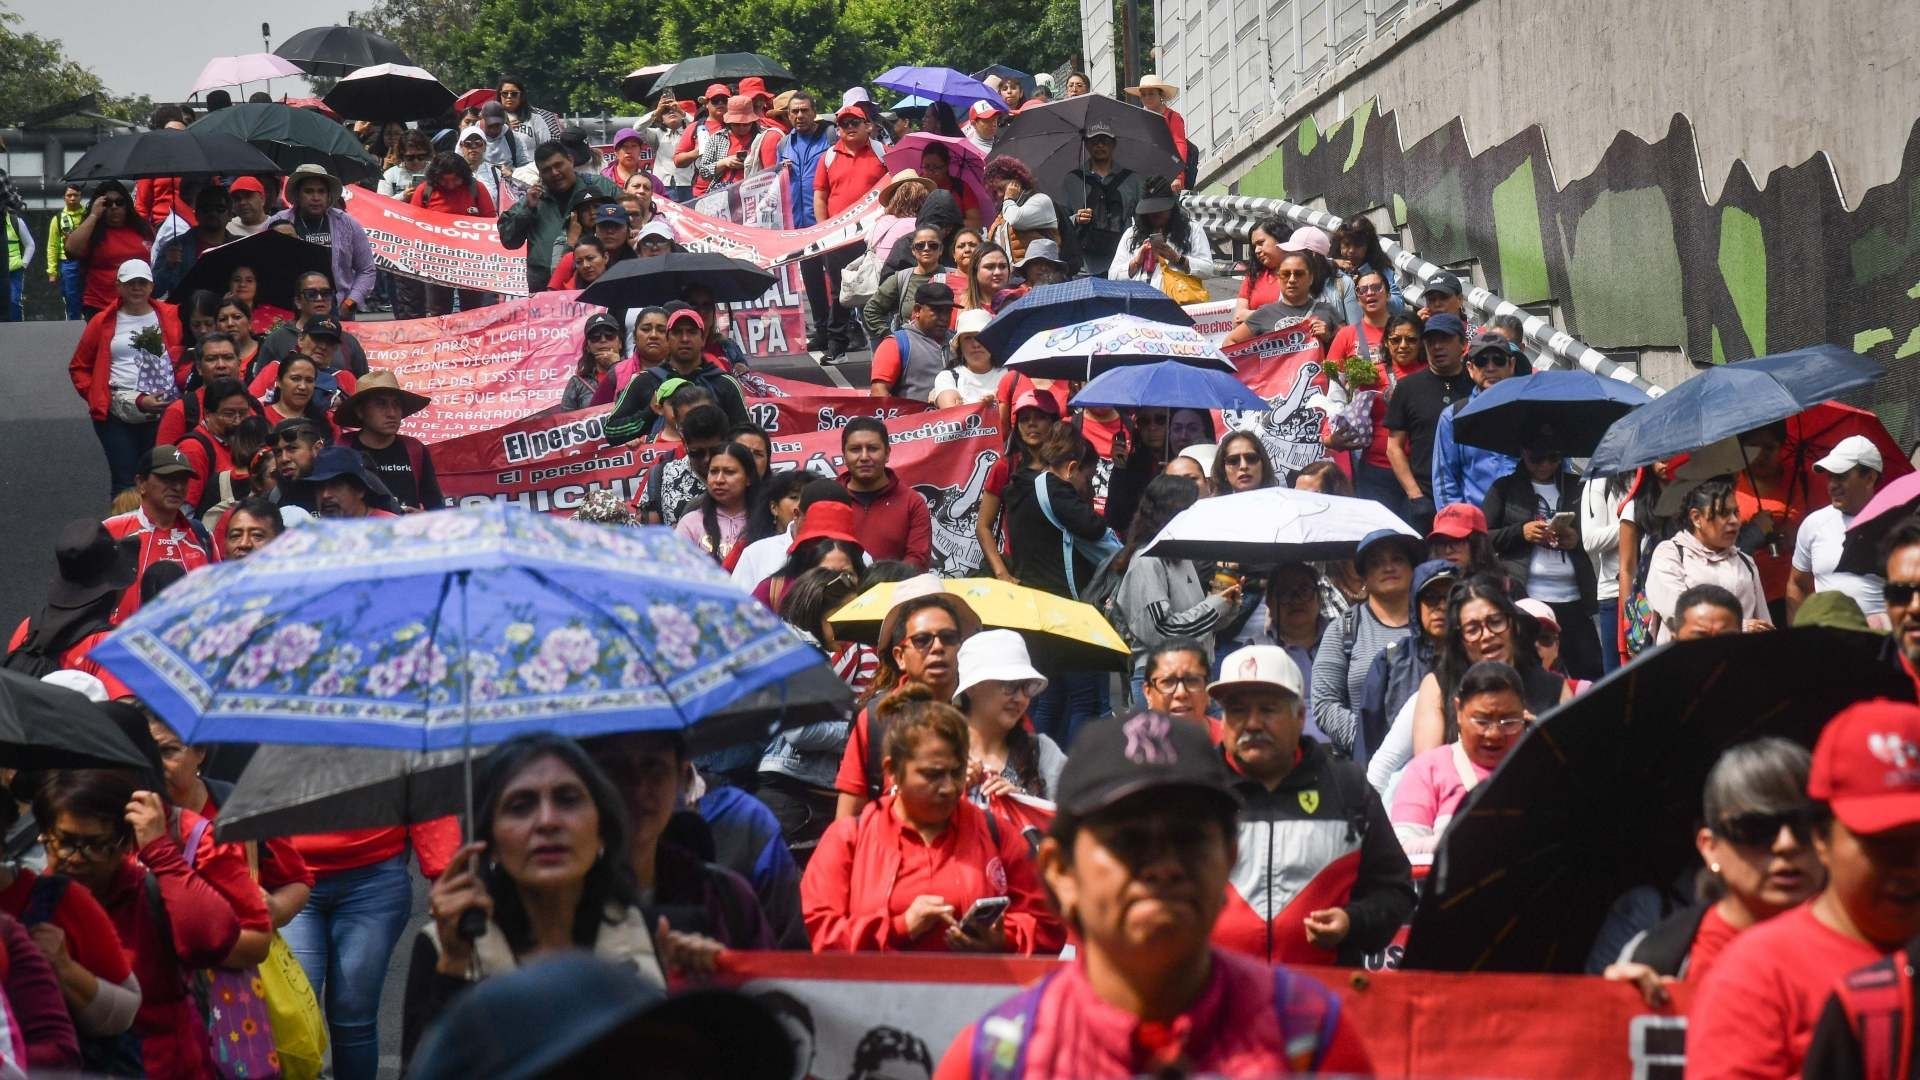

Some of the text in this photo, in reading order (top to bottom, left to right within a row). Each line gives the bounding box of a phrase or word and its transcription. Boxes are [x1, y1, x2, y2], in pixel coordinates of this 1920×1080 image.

[382, 244, 396, 254] al
[400, 249, 459, 267] sistema
[415, 239, 483, 260] iniciativa
[489, 253, 507, 263] de
[411, 346, 427, 357] AL
[490, 328, 537, 345] LUCHA
[542, 328, 570, 340] POR
[1288, 331, 1305, 346] 9
[418, 377, 446, 391] LEY
[450, 375, 476, 387] DEL
[540, 368, 558, 381] DE
[465, 391, 495, 406] QUE
[751, 404, 779, 431] 12
[966, 414, 982, 430] 9
[935, 426, 997, 443] DEMOCRÁTICA
[504, 432, 530, 462] El
[497, 470, 522, 485] El
[530, 451, 634, 483] personal
